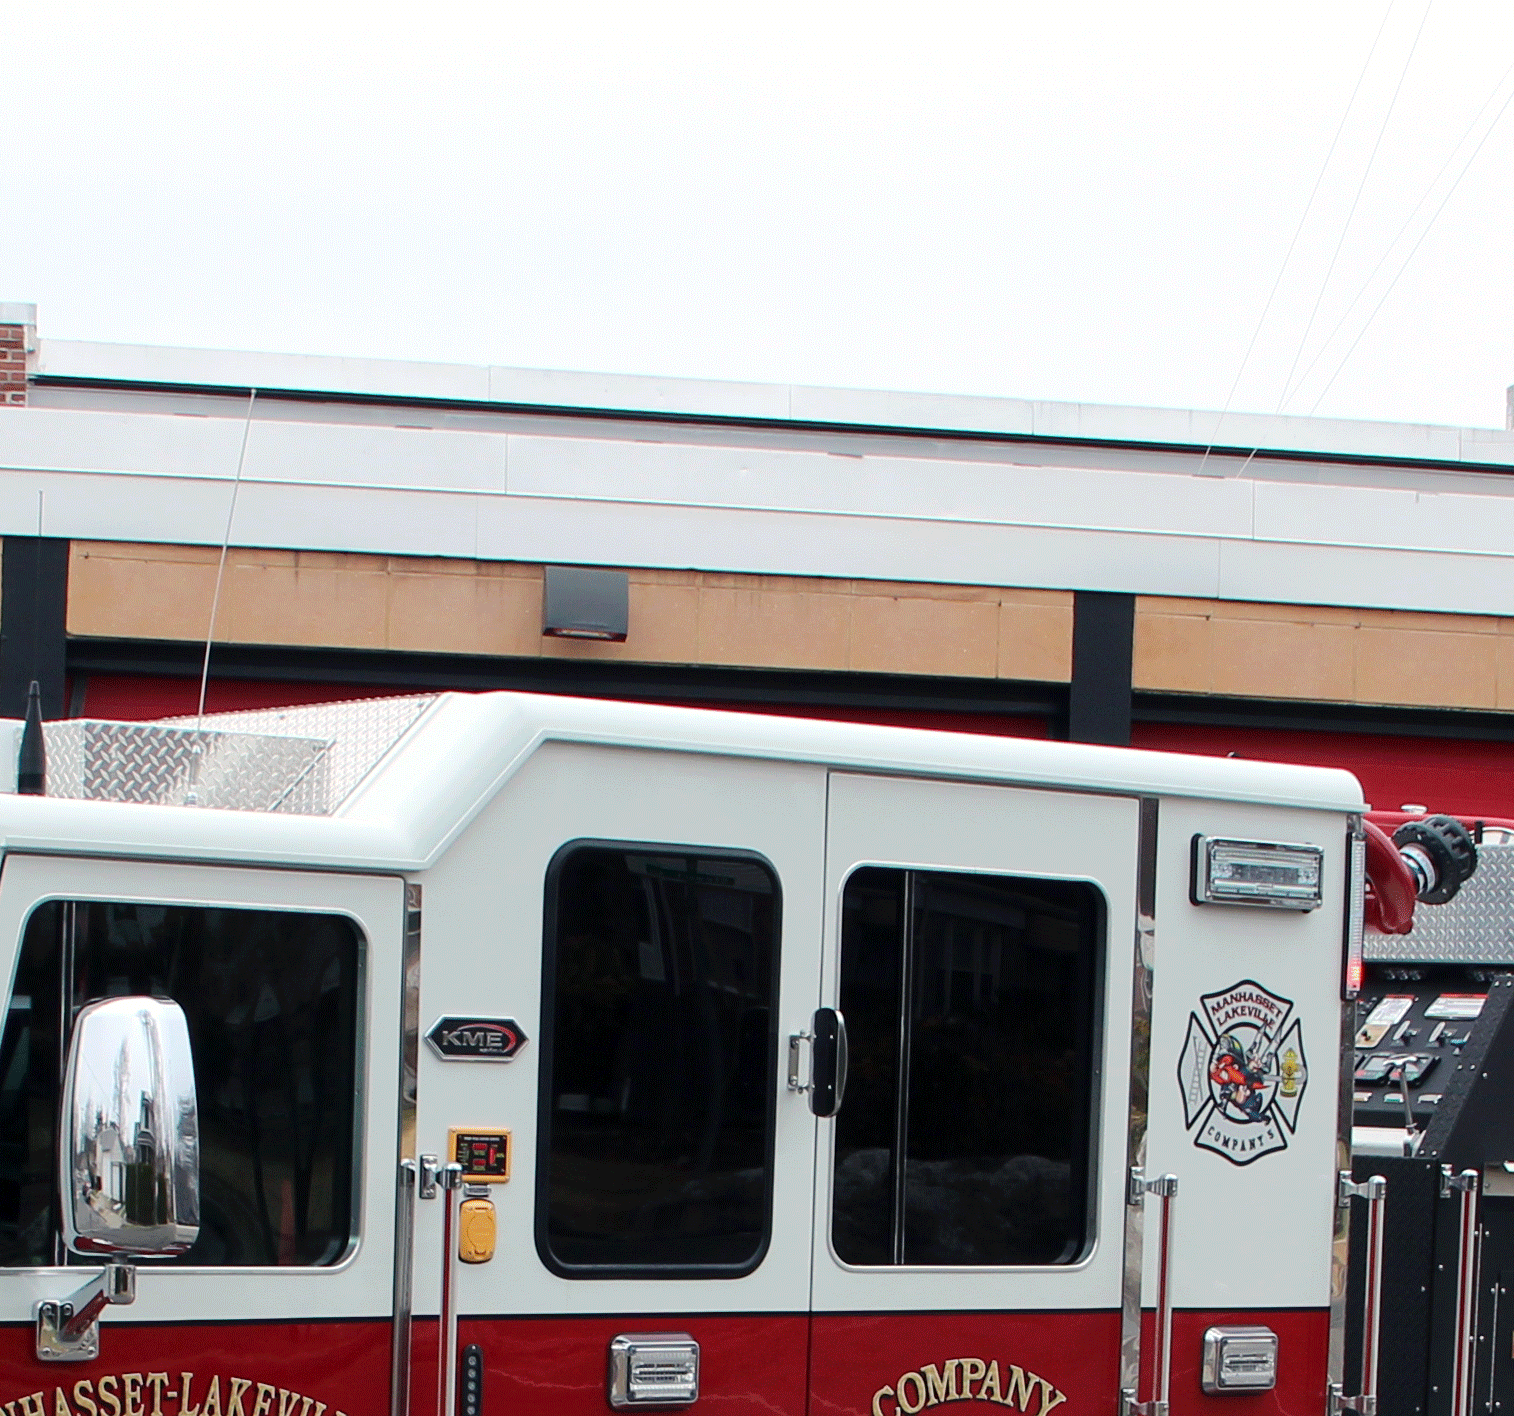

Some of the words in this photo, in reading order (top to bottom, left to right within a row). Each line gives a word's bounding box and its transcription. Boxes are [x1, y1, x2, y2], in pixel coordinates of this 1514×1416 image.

[1210, 991, 1283, 1019] MANHASSET
[1216, 1005, 1276, 1031] LAKEVILLE
[442, 1031, 503, 1047] KME
[1207, 1125, 1265, 1151] COMPANY
